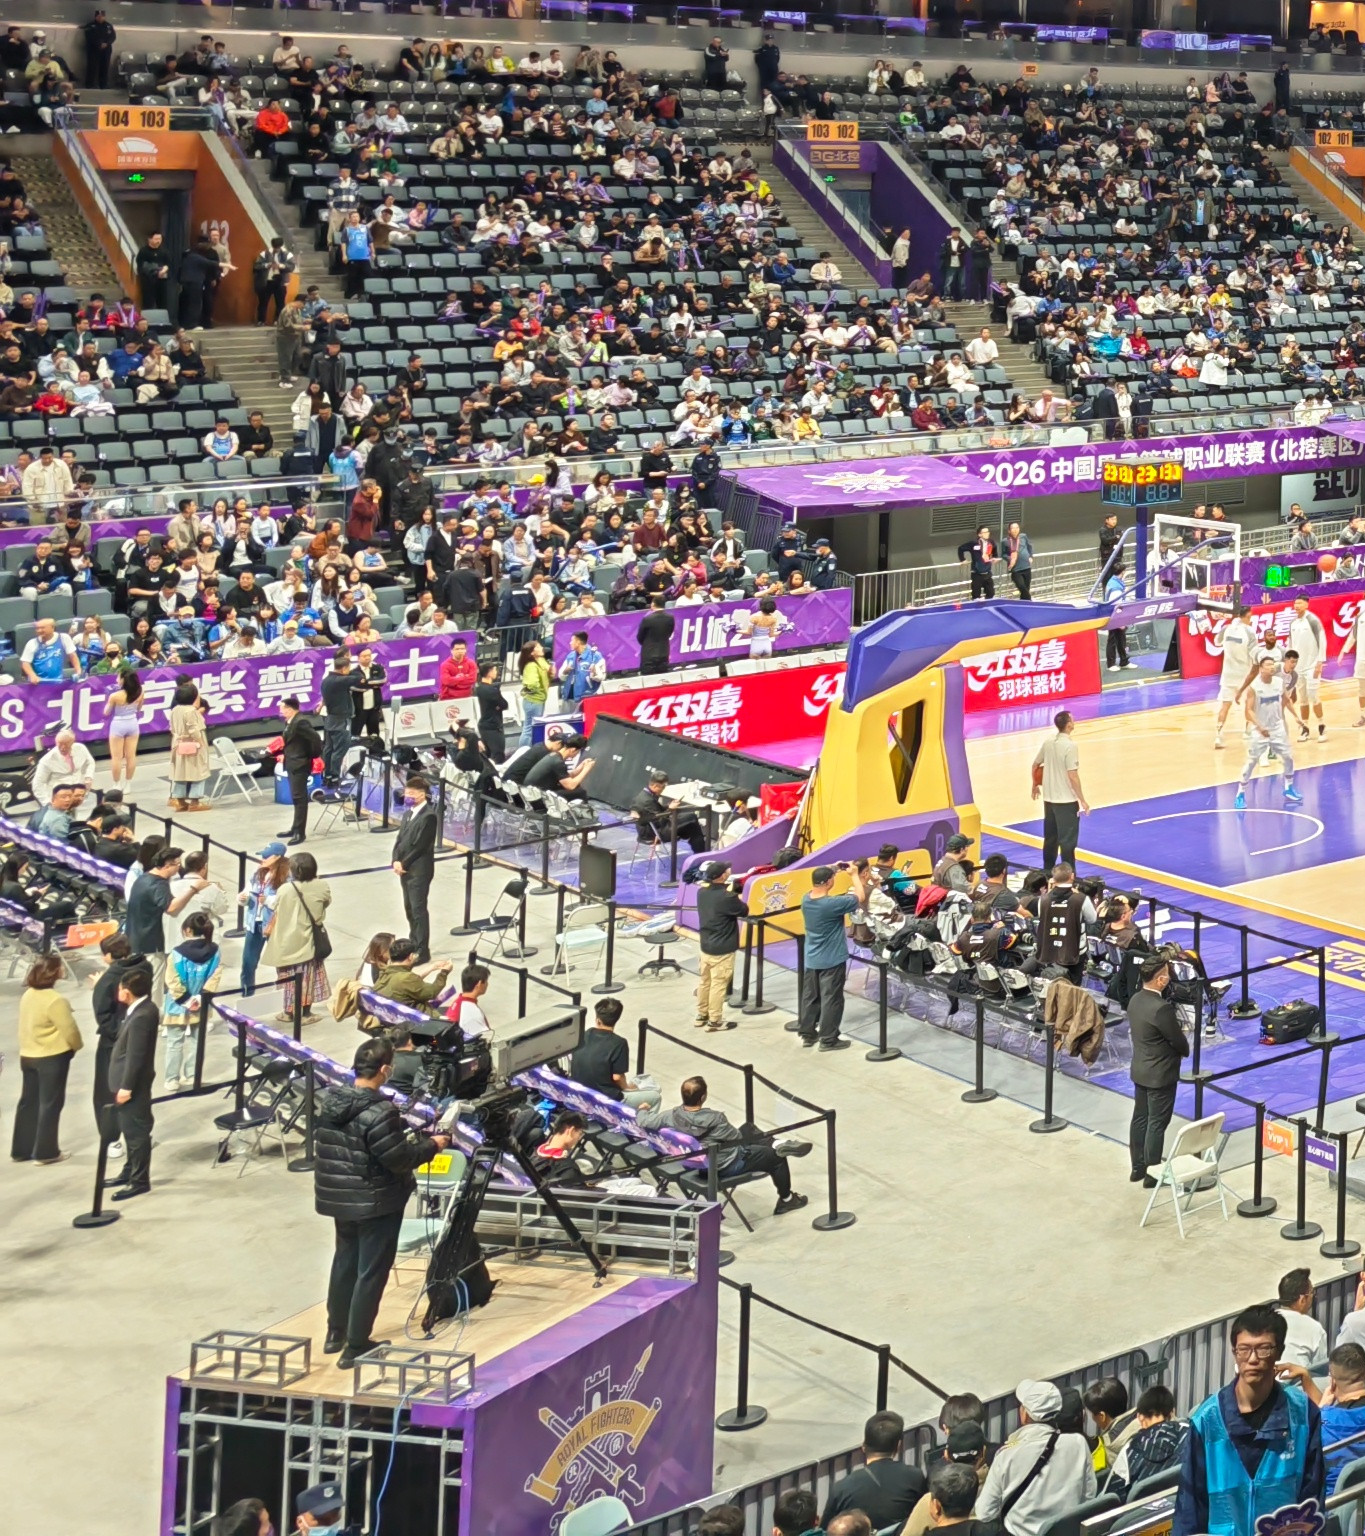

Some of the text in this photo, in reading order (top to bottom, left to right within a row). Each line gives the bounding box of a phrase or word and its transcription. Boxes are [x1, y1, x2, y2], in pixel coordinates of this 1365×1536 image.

[104, 109, 165, 128] 104 103
[812, 124, 854, 139] 103 102
[1319, 132, 1350, 144] 102 101
[975, 638, 1067, 677] 红双喜
[998, 669, 1067, 700] 羽球器材
[632, 682, 743, 728] 红双喜
[668, 718, 741, 746] 乓器材
[557, 1404, 635, 1465] ROYAL FIGHTERS
